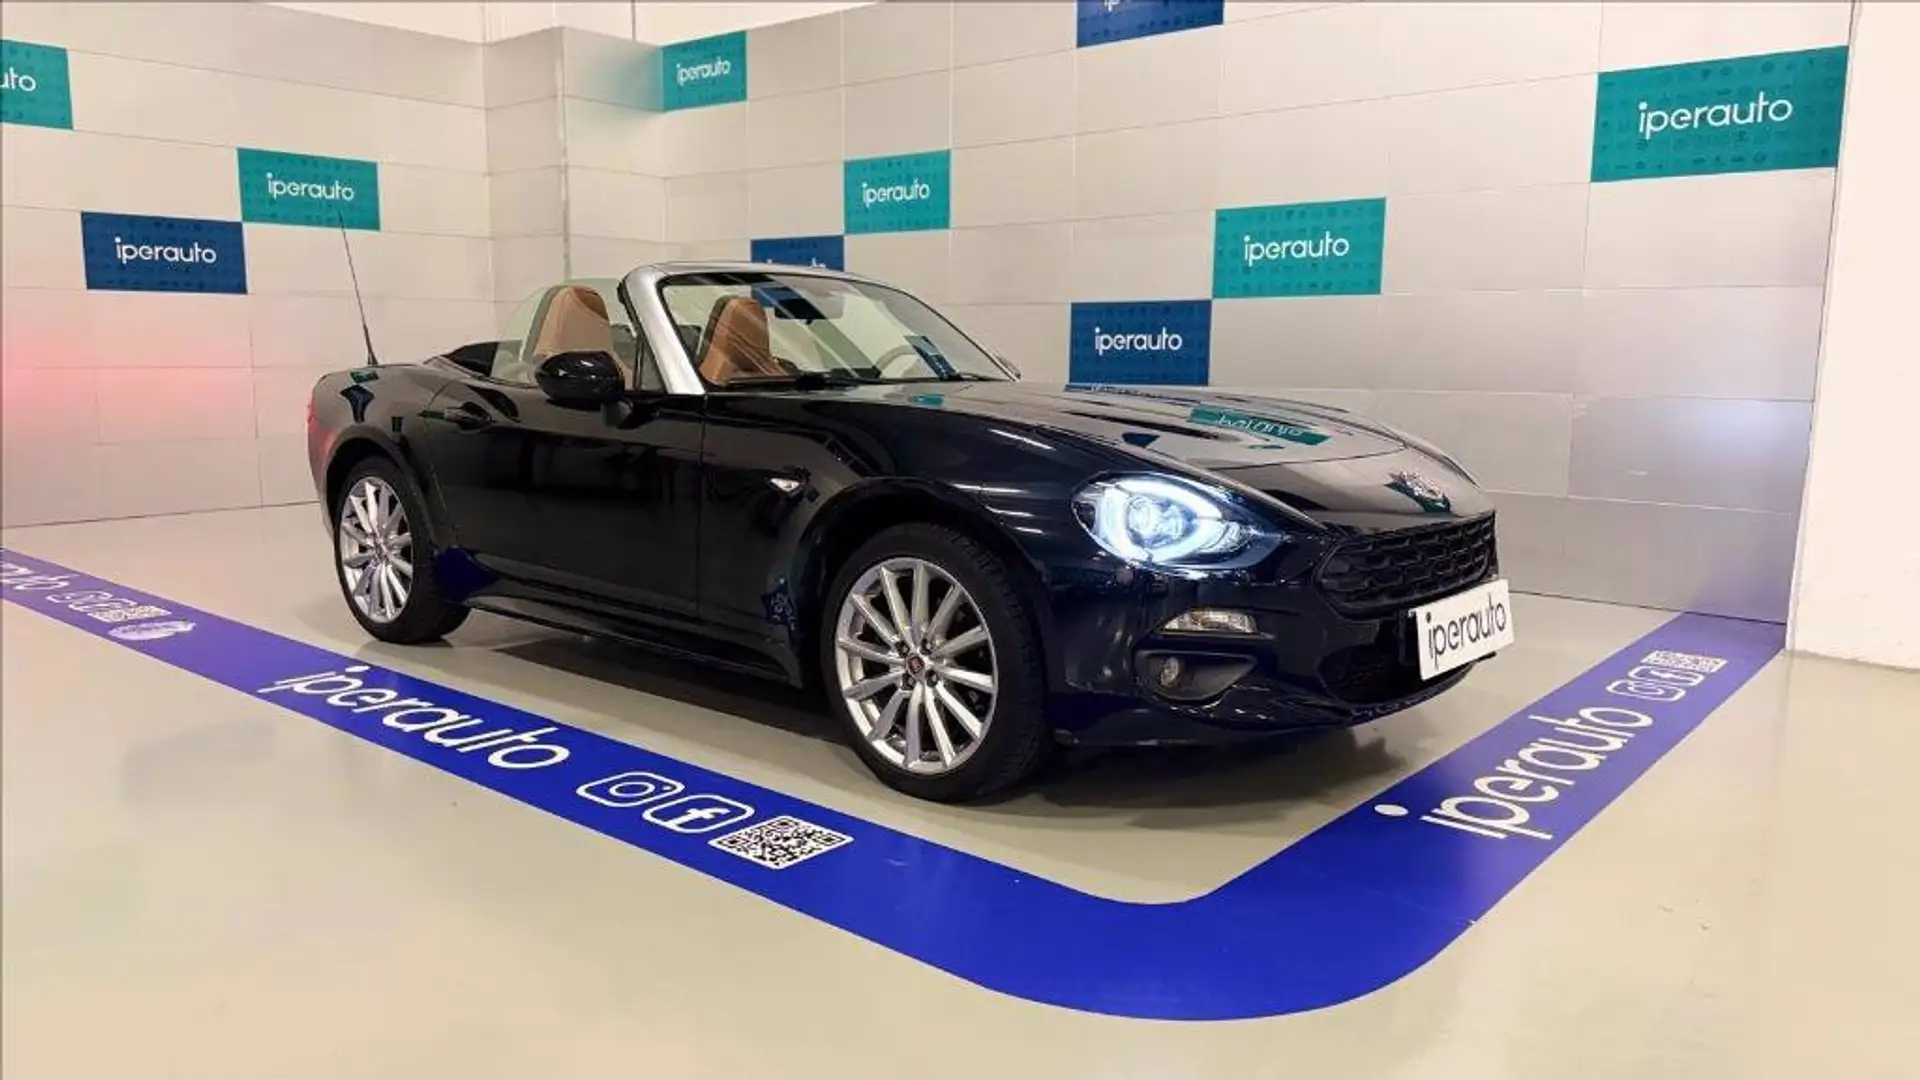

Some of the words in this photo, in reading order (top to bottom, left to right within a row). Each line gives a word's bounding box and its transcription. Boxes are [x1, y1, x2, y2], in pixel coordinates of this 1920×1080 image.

[676, 59, 730, 85] iperauto
[1638, 91, 1793, 141] iperauto
[266, 172, 354, 202] iperauto
[861, 179, 930, 207] iperauto
[114, 236, 217, 266] iperauto
[1243, 232, 1349, 267] iperauto
[1094, 326, 1183, 356] iperauto
[1426, 595, 1506, 664] iperauto
[258, 665, 569, 770] iperauto
[1374, 705, 1654, 840] iperauto
